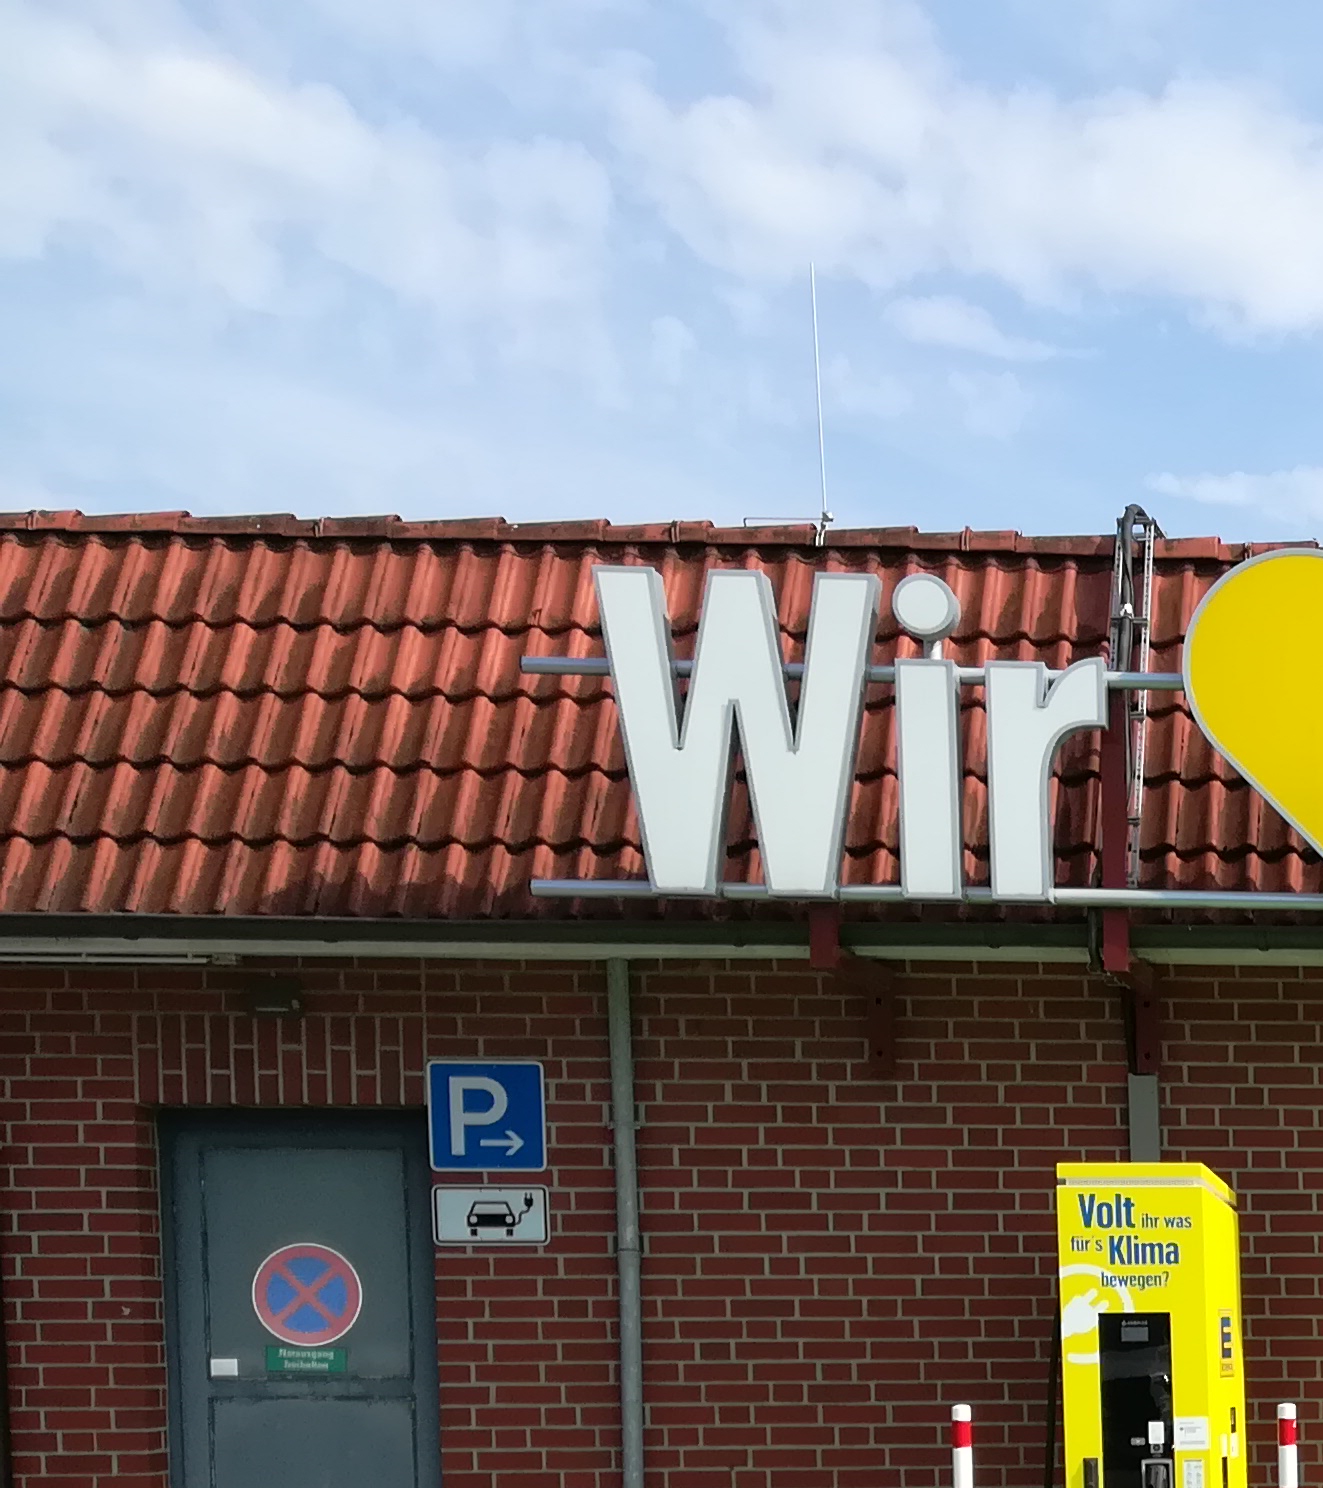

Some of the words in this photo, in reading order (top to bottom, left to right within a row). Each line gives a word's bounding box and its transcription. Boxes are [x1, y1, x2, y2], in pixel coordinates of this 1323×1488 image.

[592, 565, 1109, 900] Wir
[448, 1075, 509, 1156] P
[1077, 1193, 1136, 1229] Volt
[1141, 1213, 1160, 1229] ihr
[1164, 1216, 1192, 1229] was
[1108, 1235, 1180, 1265] Klima
[1101, 1271, 1170, 1291] bewegen?
